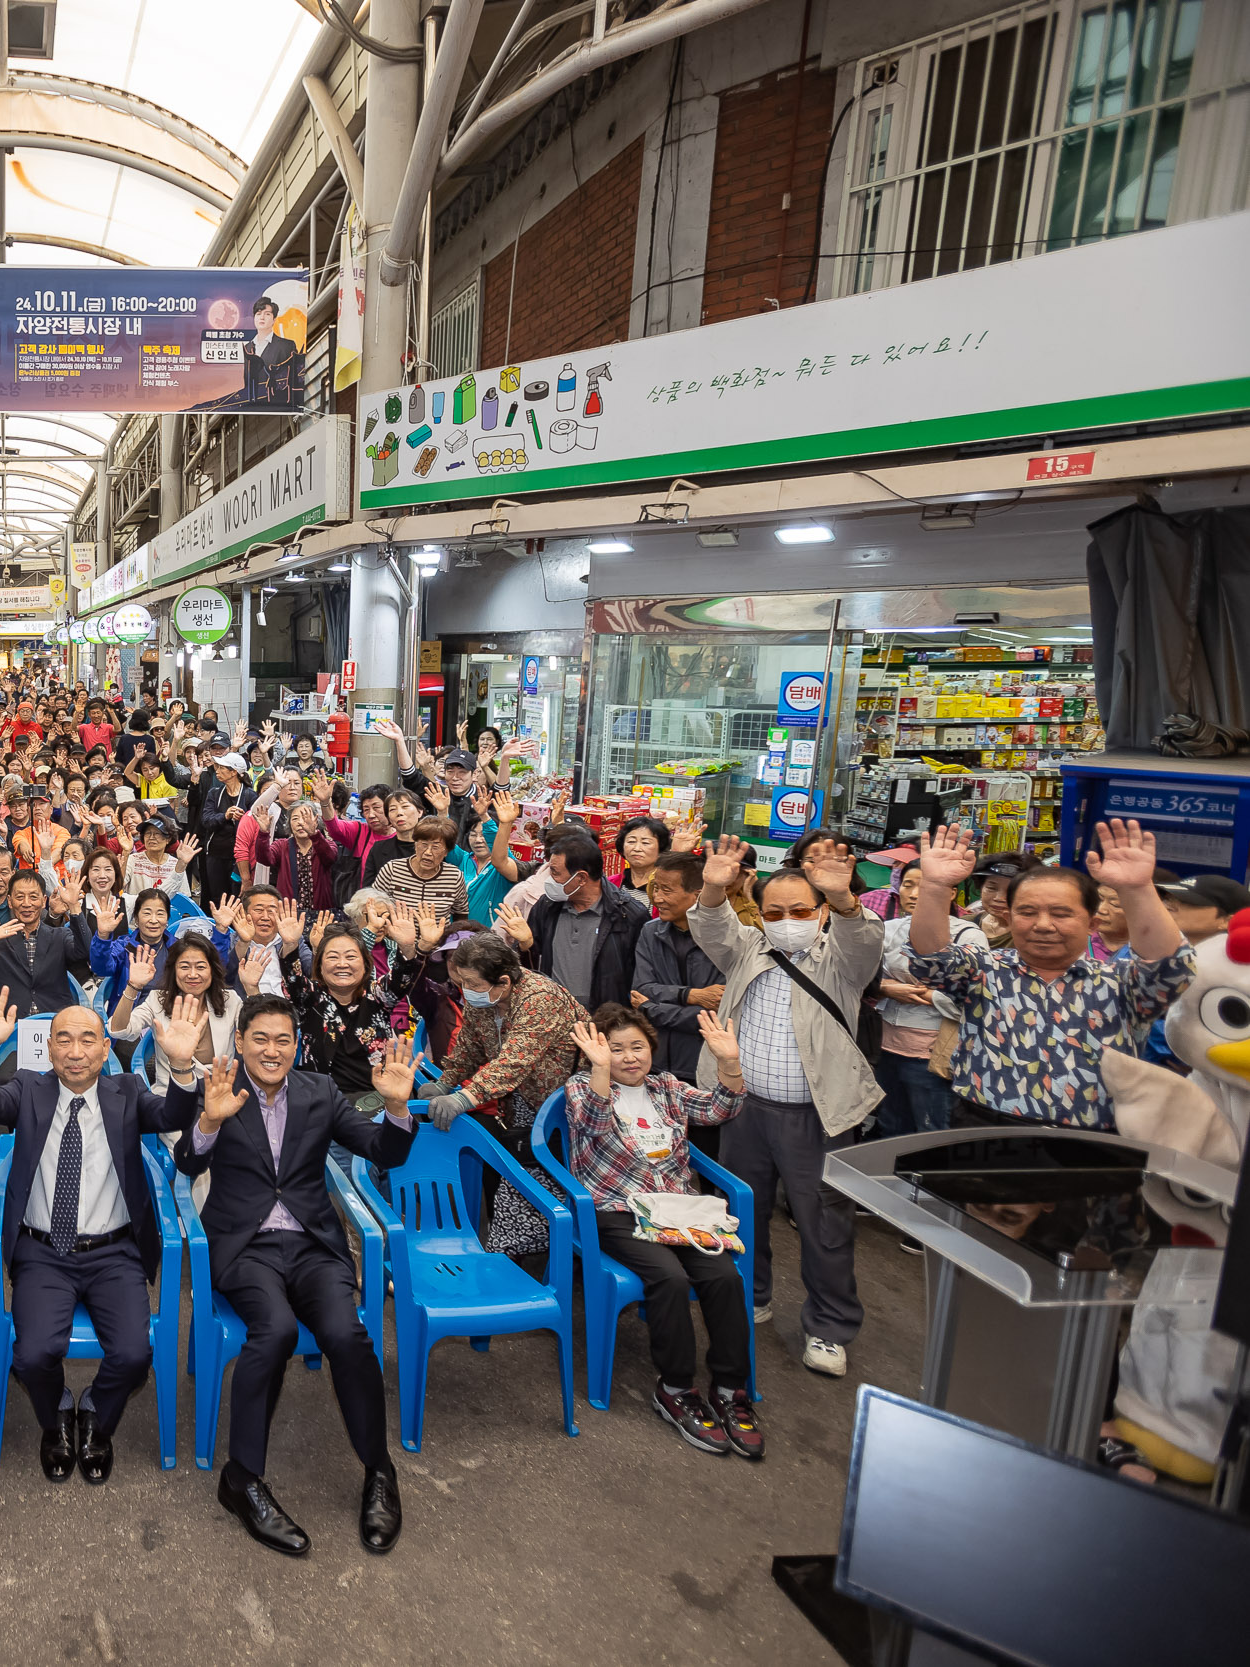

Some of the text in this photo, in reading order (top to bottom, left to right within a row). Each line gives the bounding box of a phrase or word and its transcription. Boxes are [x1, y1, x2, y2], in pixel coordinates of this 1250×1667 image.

[15, 290, 197, 313] 24.10.11.(금) 16:00~20:00
[15, 316, 142, 336] 자양전통시장 내
[232, 331, 245, 339] 가수
[18, 344, 37, 355] 고객
[646, 379, 703, 405] 상품의
[795, 353, 838, 382] 뭐든
[849, 353, 872, 366] 다
[1044, 456, 1069, 473] 15
[222, 444, 316, 535] WOORI MART
[175, 506, 215, 562] 우리마트생선
[181, 599, 224, 612] 우리마트
[192, 613, 213, 627] 생선
[196, 631, 210, 640] 생선
[789, 685, 822, 700] 담배
[1109, 794, 1164, 809] 은행공동
